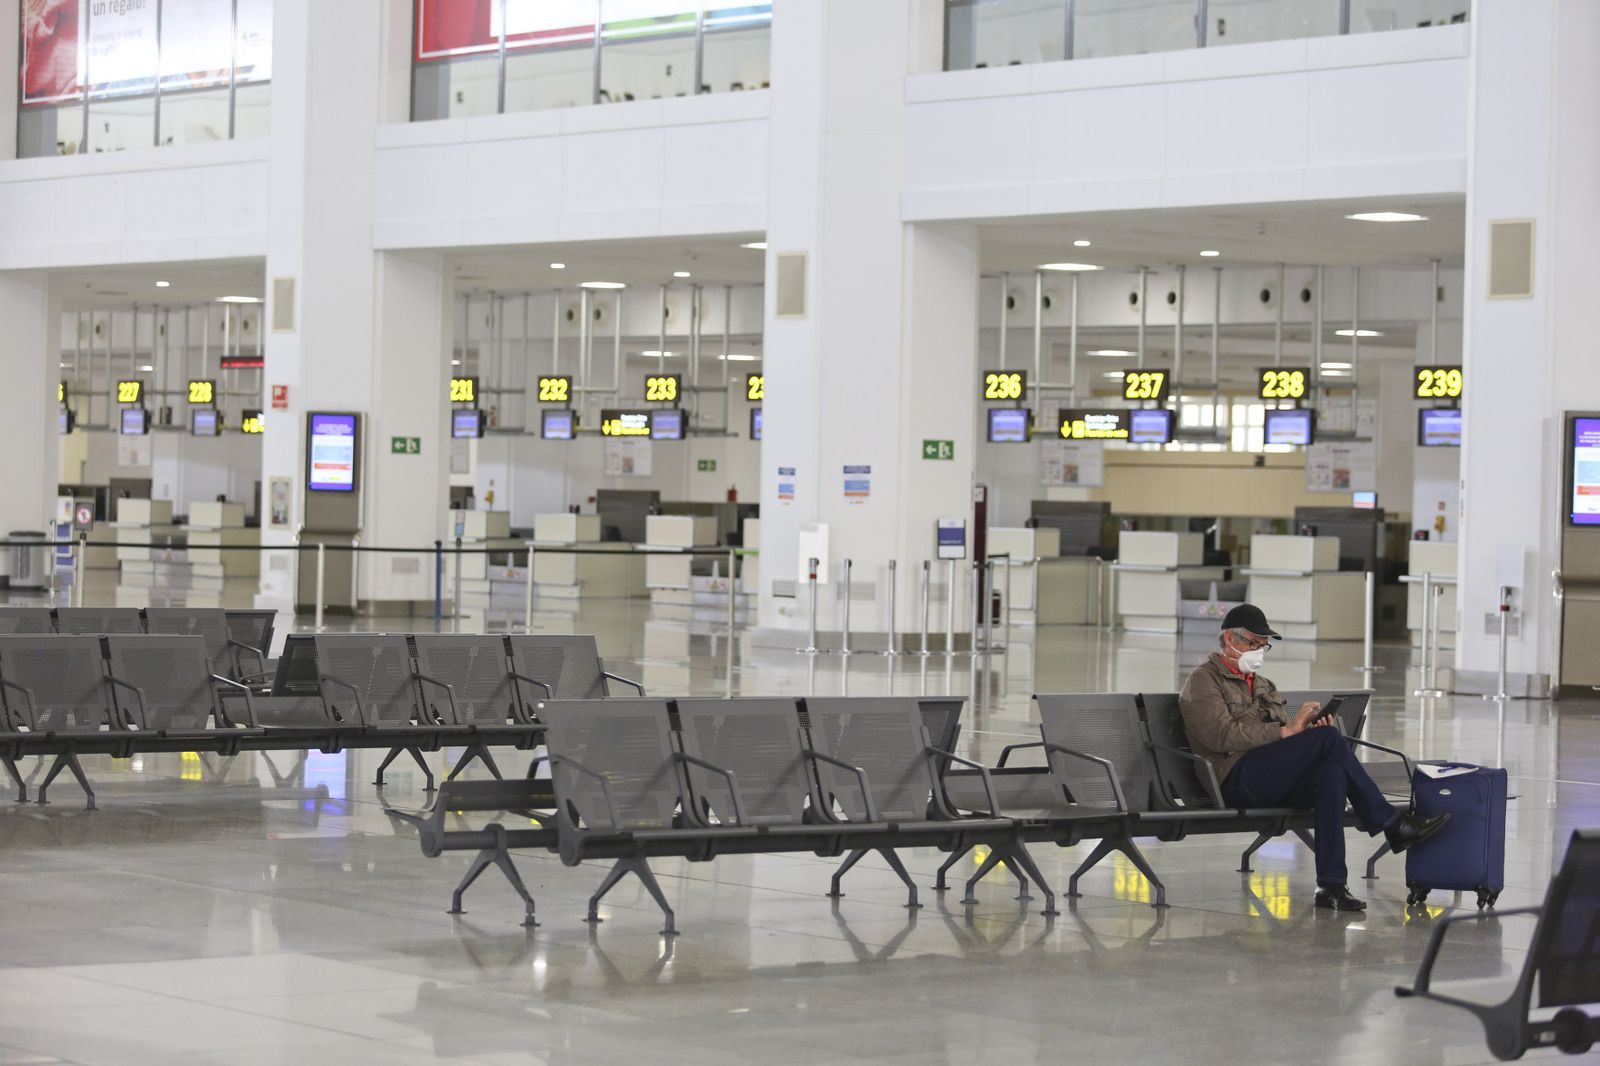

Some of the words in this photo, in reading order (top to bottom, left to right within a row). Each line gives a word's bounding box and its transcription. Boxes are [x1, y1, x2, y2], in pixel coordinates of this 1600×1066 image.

[93, 2, 106, 17] un
[119, 382, 140, 402] 227
[450, 379, 474, 401] 231
[540, 378, 568, 401] 232
[647, 377, 677, 401] 233
[986, 373, 1022, 399] 236
[1126, 372, 1164, 398] 237
[1262, 371, 1304, 398] 238
[1417, 369, 1462, 397] 239
